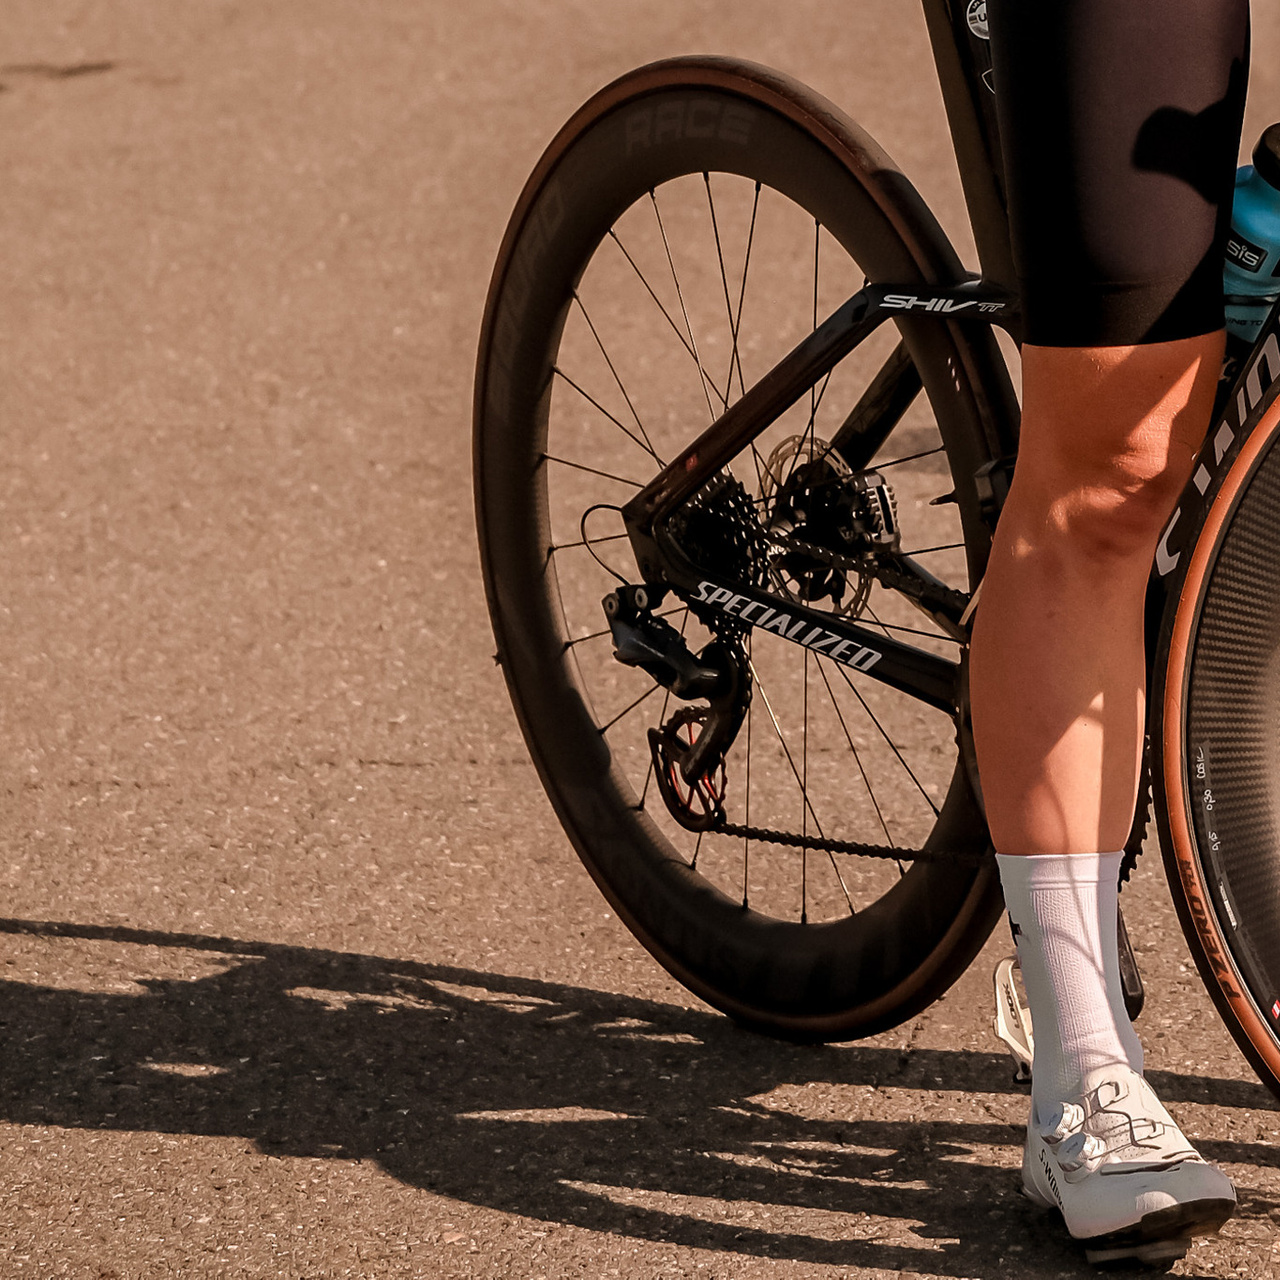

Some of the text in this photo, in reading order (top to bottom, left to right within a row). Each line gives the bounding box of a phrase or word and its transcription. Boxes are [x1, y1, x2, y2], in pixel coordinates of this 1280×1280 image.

[624, 99, 758, 154] RACE
[878, 294, 978, 313] SHIV
[689, 579, 883, 672] SPECIALIZED
[1002, 982, 1020, 1029] LOOK
